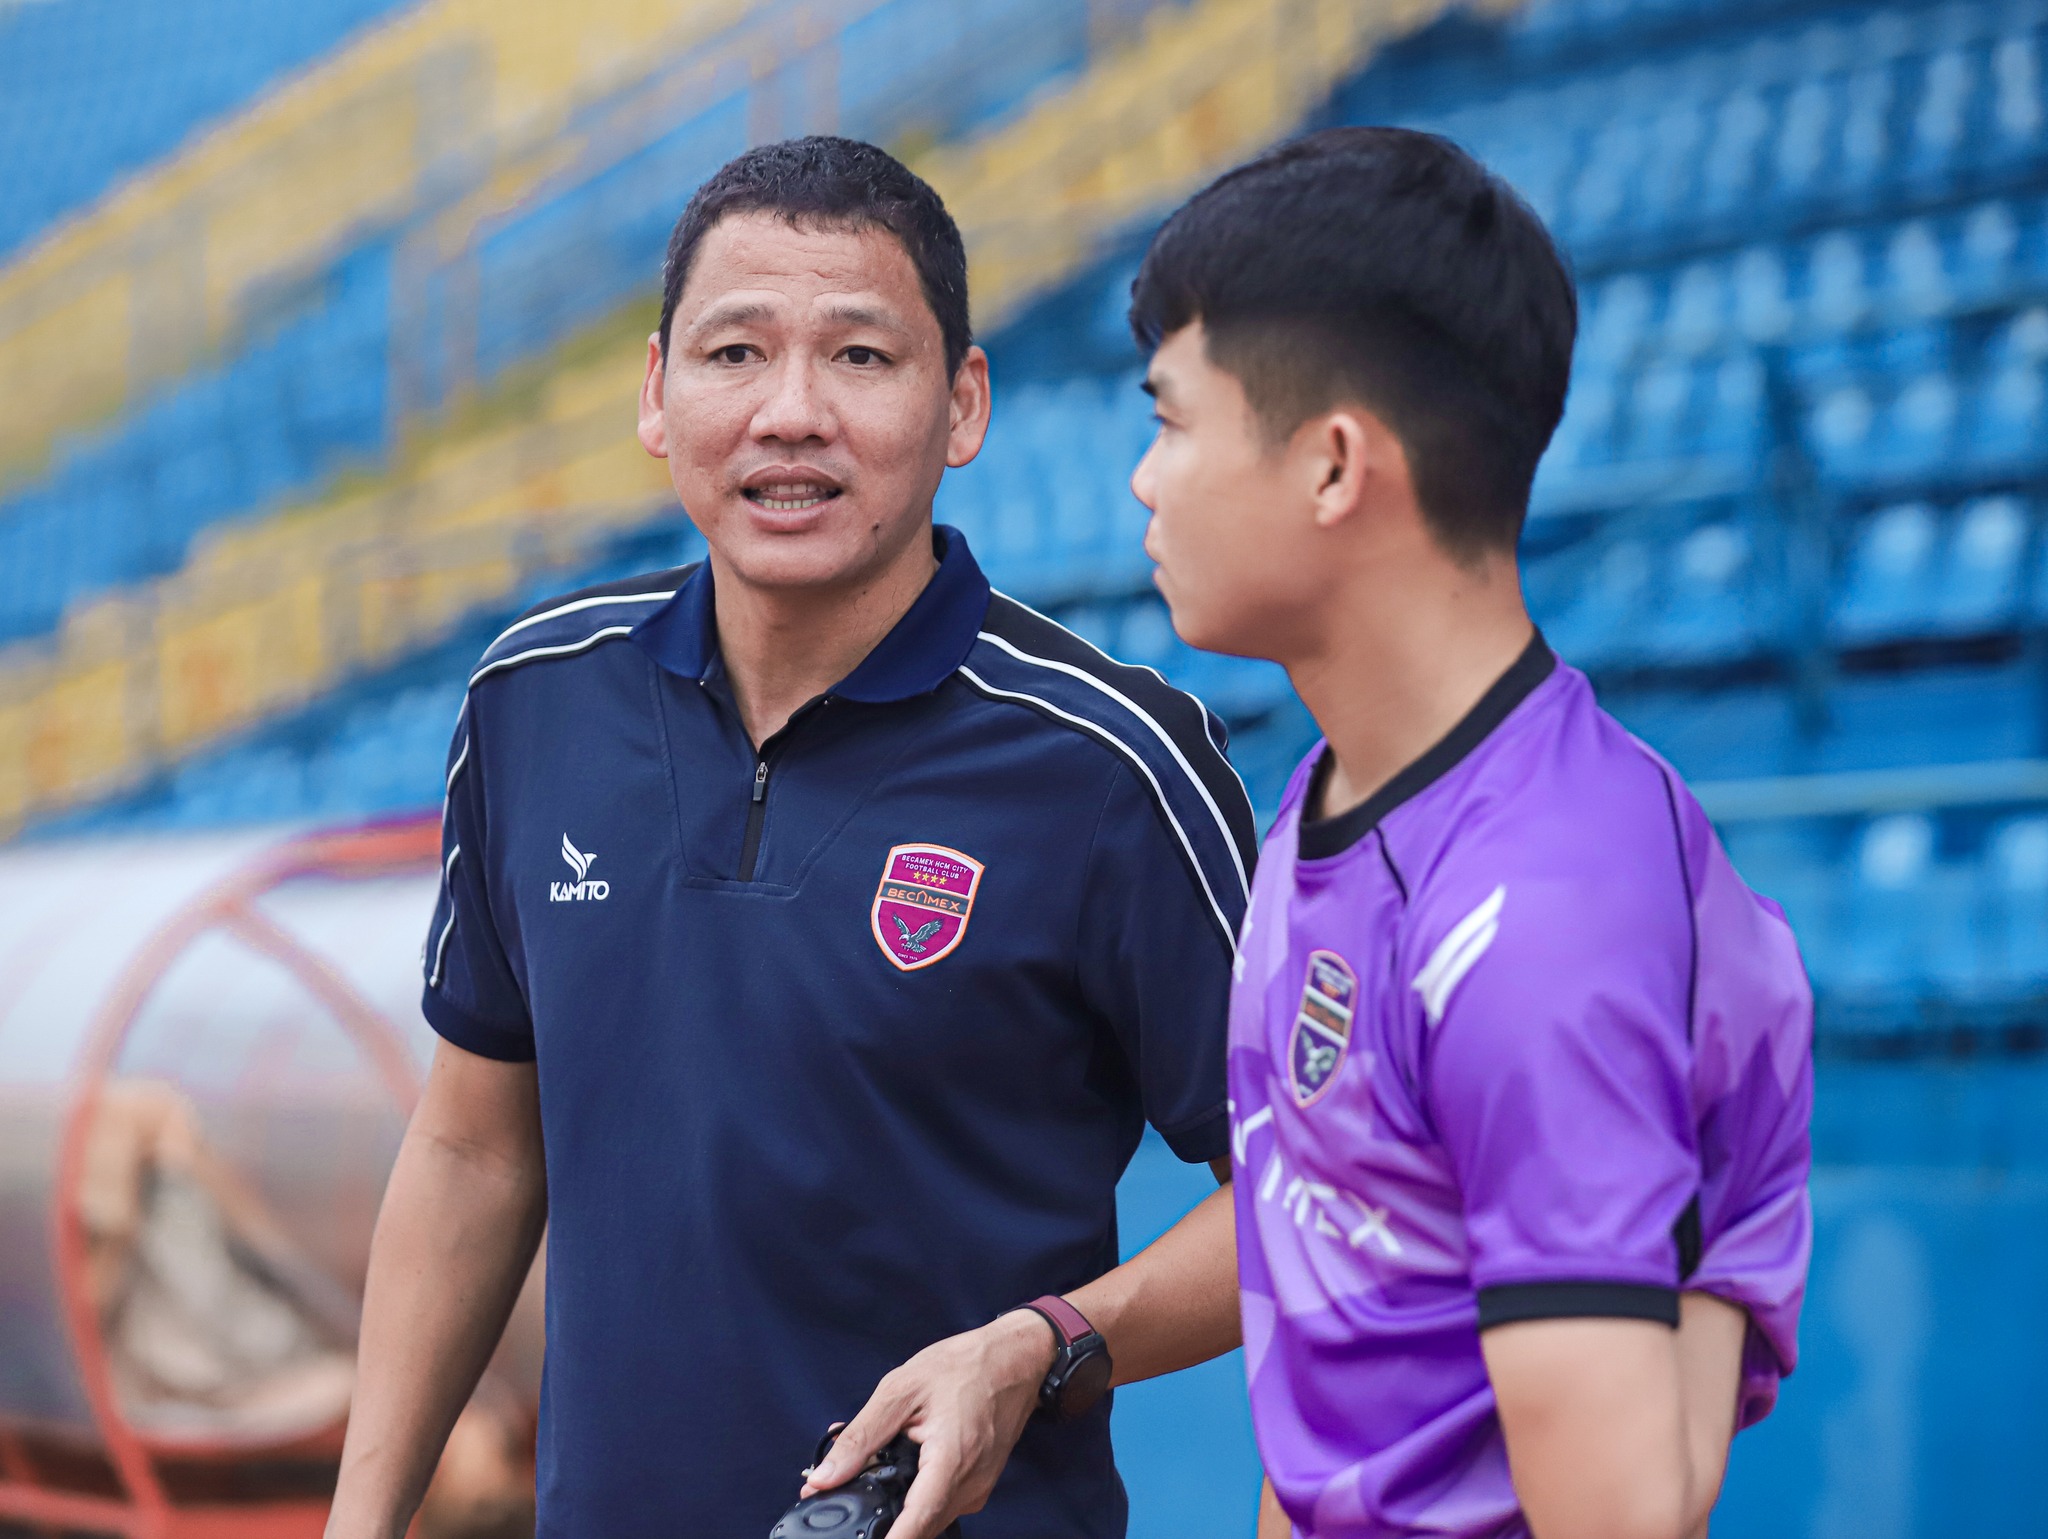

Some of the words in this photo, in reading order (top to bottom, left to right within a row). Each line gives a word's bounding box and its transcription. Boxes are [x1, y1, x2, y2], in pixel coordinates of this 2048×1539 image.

[901, 854, 933, 866] BECAMEX
[934, 861, 951, 870] HCM
[952, 865, 969, 874] CITY
[905, 862, 939, 875] FOOTBALL
[941, 870, 960, 879] CLUB
[549, 880, 610, 902] KAMITO
[887, 887, 961, 912] BECAMEX
